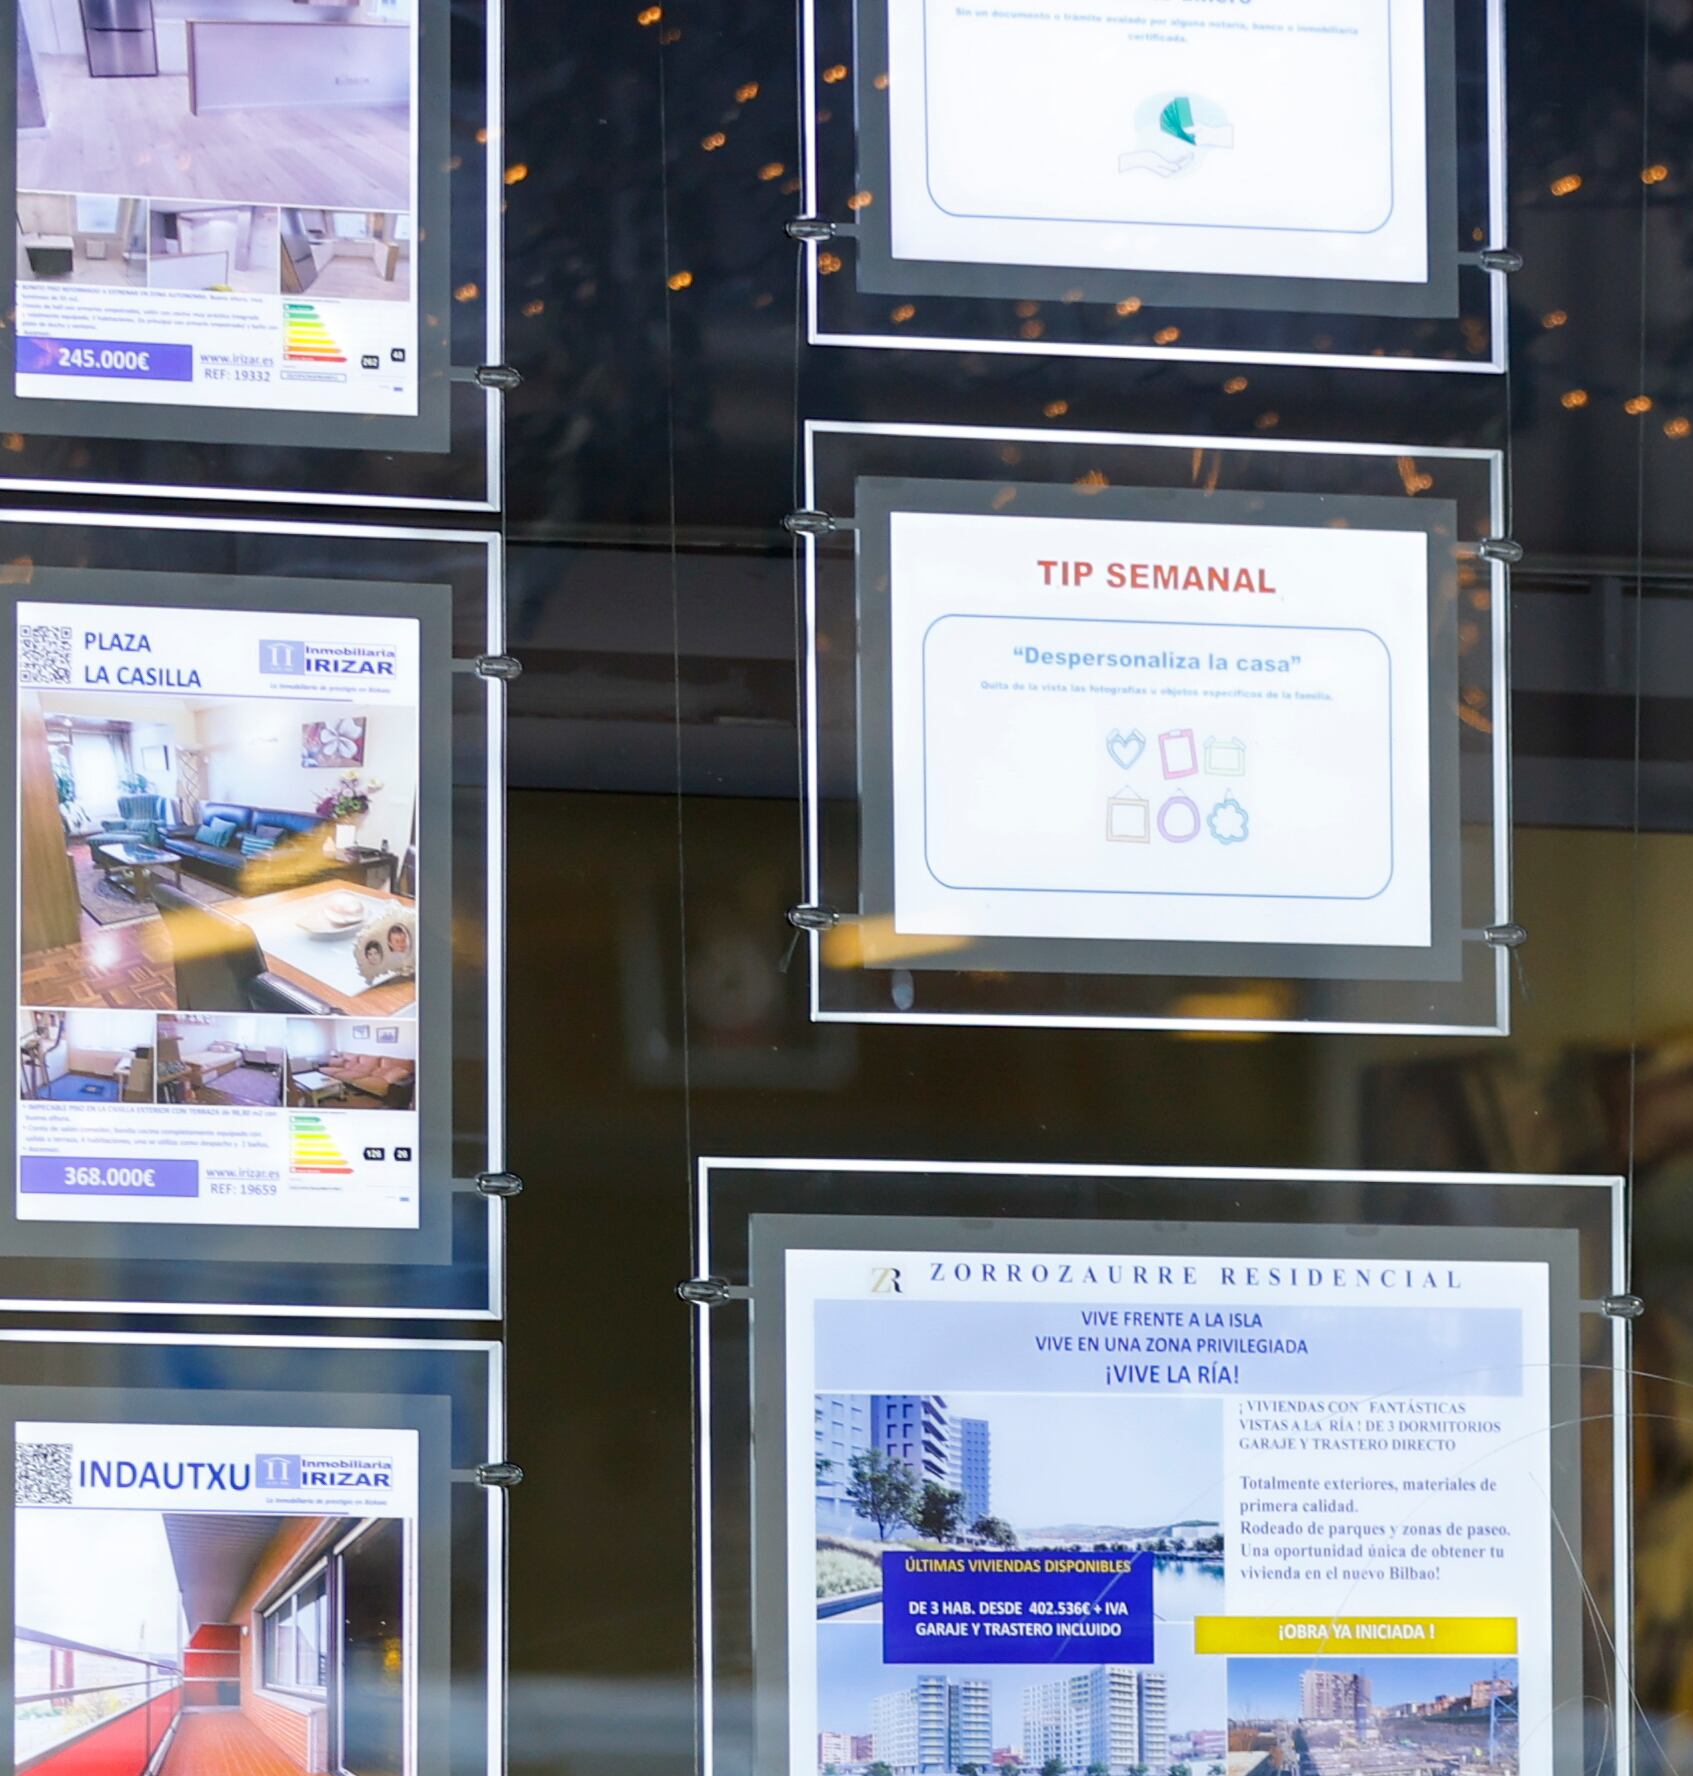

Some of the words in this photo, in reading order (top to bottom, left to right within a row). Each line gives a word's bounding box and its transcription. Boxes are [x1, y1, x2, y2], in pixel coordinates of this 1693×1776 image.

[58, 348, 149, 370] 245.000€
[205, 368, 229, 379] REF:
[235, 370, 270, 382] 19332
[1037, 560, 1093, 586] TIP
[1107, 563, 1276, 593] SEMANAL
[85, 632, 151, 652] PLAZA
[305, 646, 395, 659] Inmobiliaria
[1013, 646, 1200, 670] “Despersonaliza
[1209, 653, 1228, 670] la
[1236, 656, 1301, 672] casa”
[306, 659, 393, 674] IRIZAR
[85, 666, 110, 684] LA
[117, 667, 201, 687] CASILLA
[65, 1167, 155, 1187] 368.000€
[206, 1168, 280, 1181] www.irizar.es
[210, 1183, 236, 1194] REF:
[241, 1184, 277, 1195] 19659
[931, 1263, 1196, 1284] ZORROZAURRE
[1221, 1268, 1460, 1288] RESIDENCIAL
[1082, 1312, 1118, 1326] VIVE
[1124, 1312, 1183, 1327] FRENTE
[1189, 1313, 1200, 1326] A
[1205, 1313, 1224, 1327] LA
[1230, 1313, 1262, 1328] ISLA
[1036, 1336, 1072, 1351] VIVE
[1078, 1337, 1099, 1351] EN
[1105, 1337, 1141, 1352] UNA
[1146, 1338, 1191, 1352] ZONA
[1197, 1338, 1308, 1353] PRIVILEGIADA
[1107, 1365, 1159, 1384] ¡VIVE
[1168, 1366, 1191, 1383] LA
[1198, 1361, 1238, 1384] RÍA!
[301, 1459, 392, 1469] Inmobiliaria
[80, 1461, 250, 1491] INDAUTXU
[302, 1472, 390, 1487] IRIZAR
[1240, 1476, 1320, 1490] Totalmente
[1324, 1478, 1398, 1491] exteriores,
[1403, 1478, 1476, 1491] materiales
[1480, 1478, 1496, 1491] de
[1240, 1500, 1298, 1515] primera
[1302, 1499, 1358, 1512] calidad.
[905, 1556, 965, 1572] ÚLTIMAS
[970, 1559, 1041, 1572] VIVIENDAS
[1045, 1560, 1132, 1573] DISPONIBLES
[916, 1623, 968, 1636] GARAJE
[972, 1623, 980, 1635] Y
[984, 1623, 1053, 1636] TRASTERO
[1056, 1623, 1121, 1636] INCLUIDO
